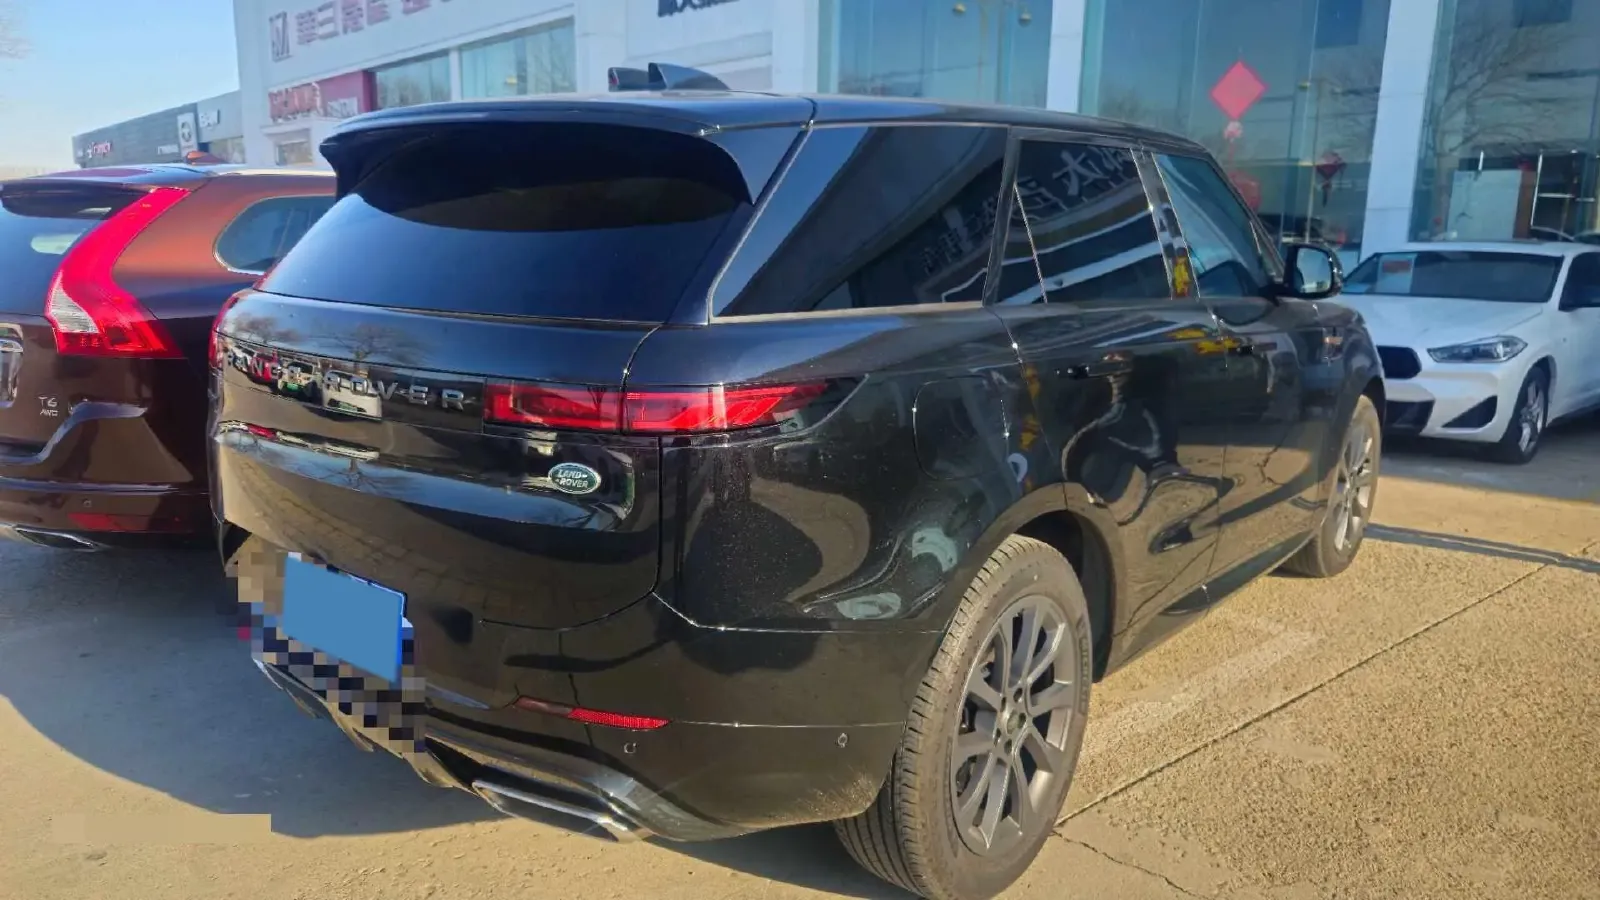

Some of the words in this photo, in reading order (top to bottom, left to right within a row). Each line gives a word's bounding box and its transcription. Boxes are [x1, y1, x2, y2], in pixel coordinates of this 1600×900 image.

[323, 370, 465, 411] ROVER
[38, 396, 58, 407] T6
[557, 469, 581, 479] LAND
[559, 478, 589, 488] ROVER
